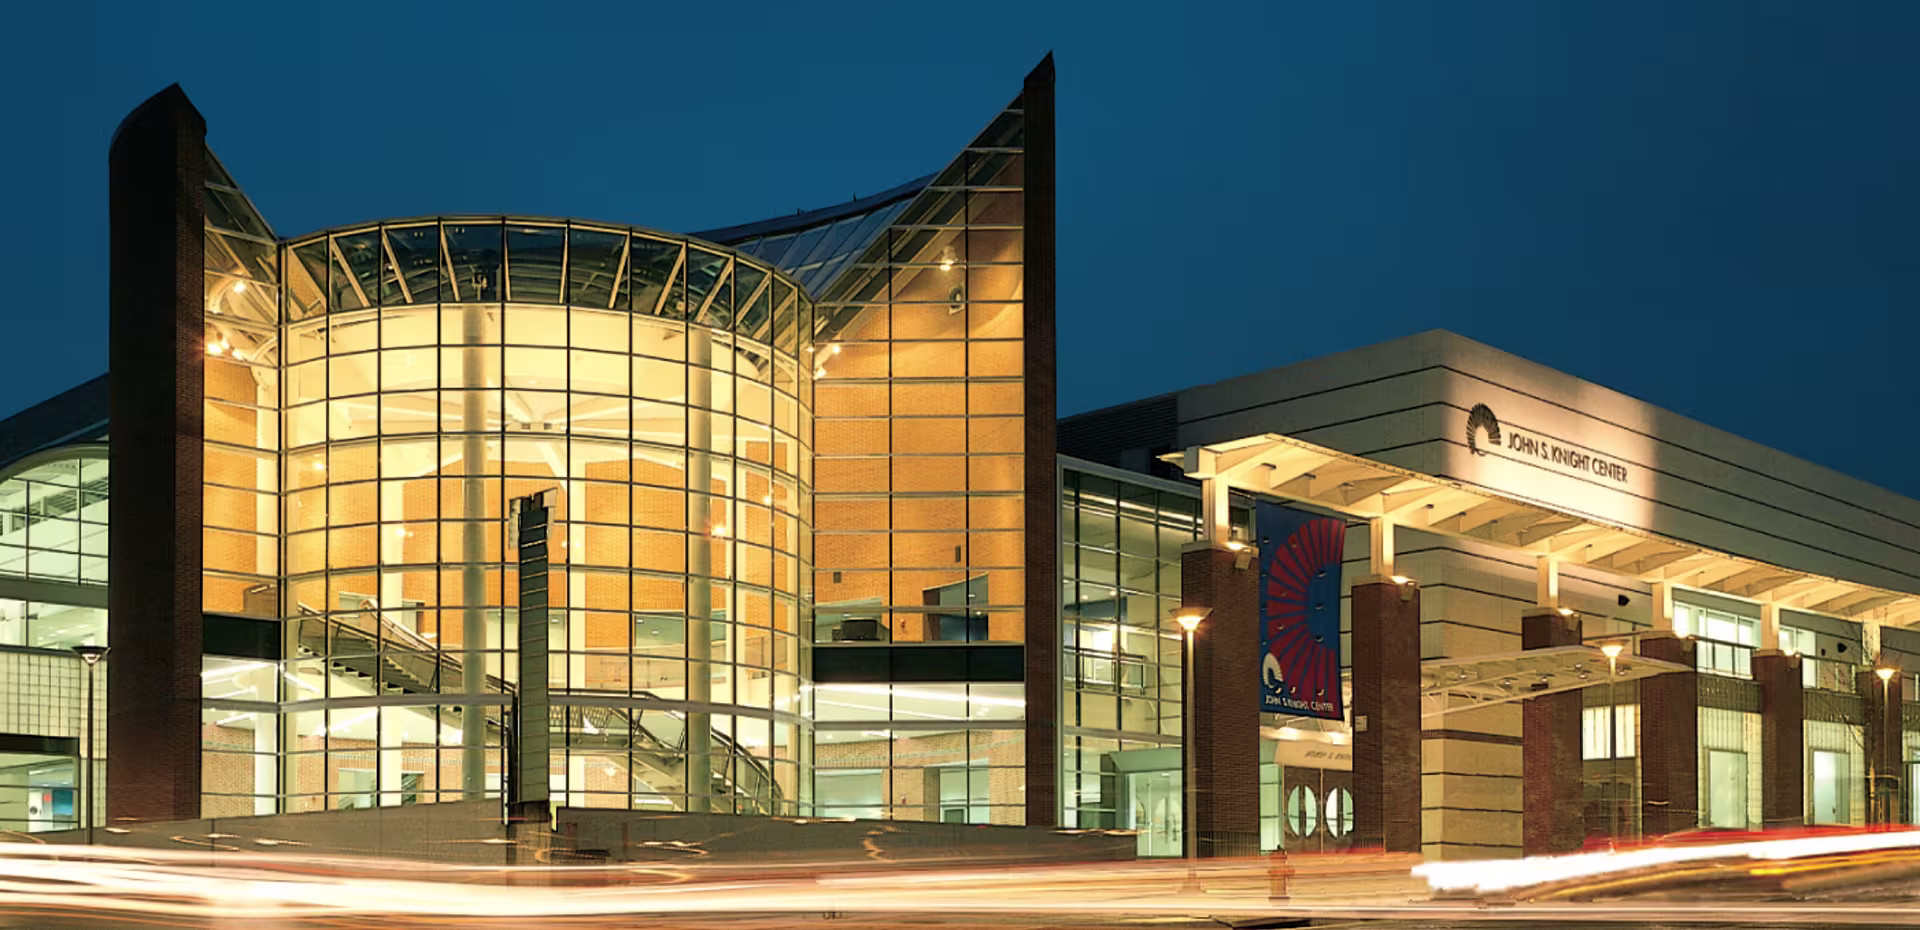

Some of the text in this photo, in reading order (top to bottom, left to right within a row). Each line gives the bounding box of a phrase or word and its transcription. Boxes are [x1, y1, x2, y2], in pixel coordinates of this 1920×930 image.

[1508, 432, 1539, 457] JOHN
[1551, 445, 1590, 472] KNIGHT
[1592, 458, 1628, 483] CENTER
[1265, 694, 1281, 705] JOHN
